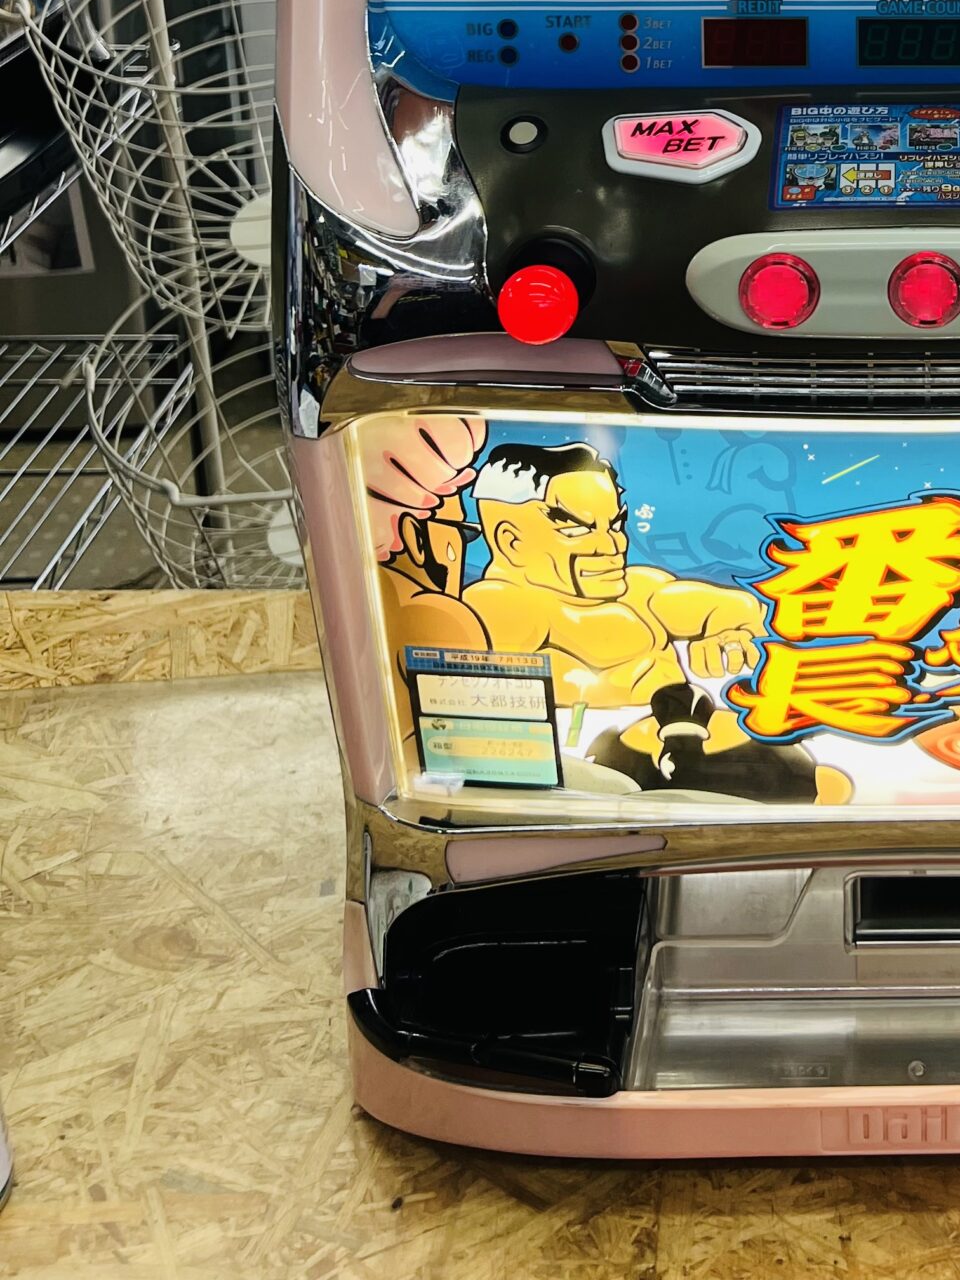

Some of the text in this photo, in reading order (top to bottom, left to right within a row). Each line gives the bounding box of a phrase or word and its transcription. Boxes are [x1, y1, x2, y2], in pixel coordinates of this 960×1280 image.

[876, 0, 925, 16] GAME
[466, 23, 494, 36] BIG
[545, 15, 593, 29] START
[466, 50, 495, 63] REG
[630, 119, 699, 137] MAX
[662, 136, 726, 154] BET
[471, 693, 546, 710] 大都技研
